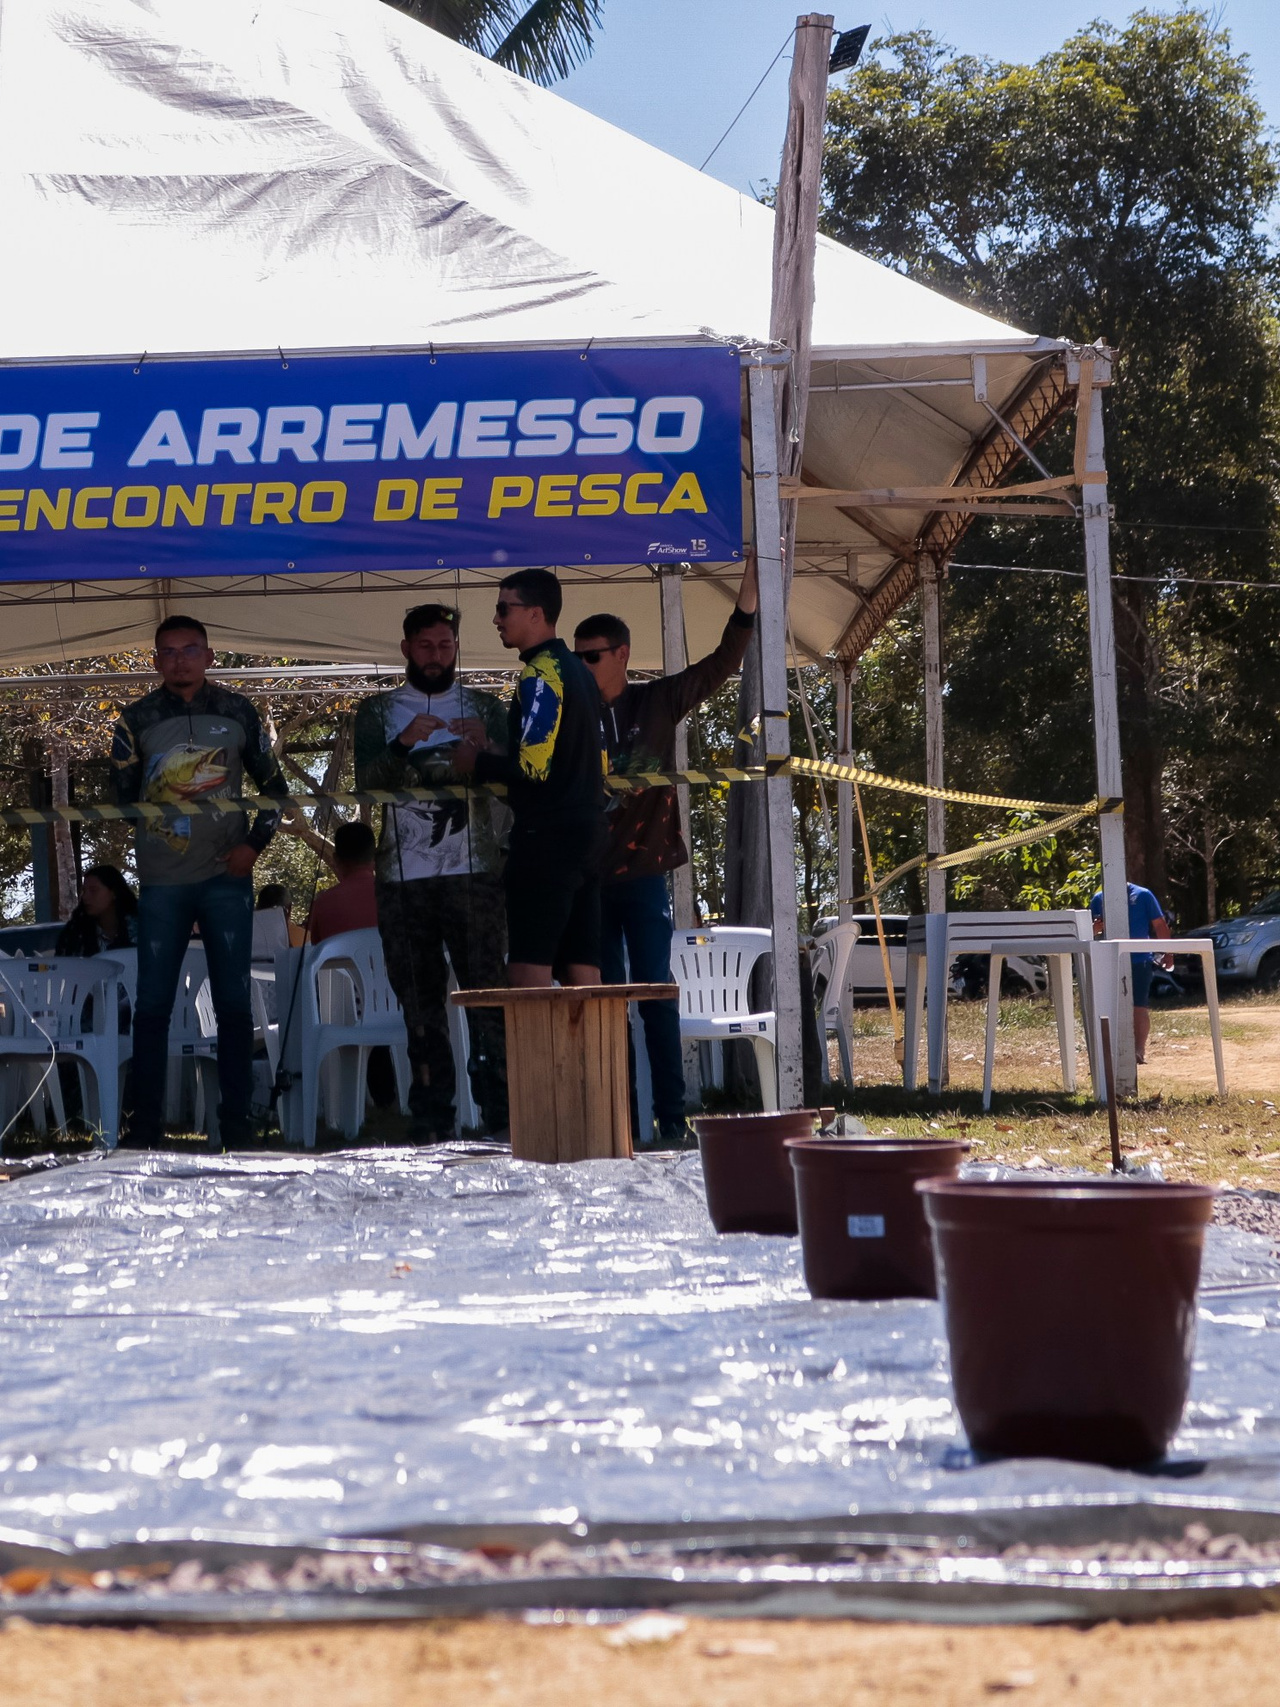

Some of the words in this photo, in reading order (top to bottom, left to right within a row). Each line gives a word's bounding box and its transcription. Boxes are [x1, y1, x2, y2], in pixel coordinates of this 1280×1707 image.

[127, 396, 704, 467] ARREMESSO
[373, 477, 463, 521] DE
[487, 472, 708, 518] PESCA
[690, 539, 707, 551] 15
